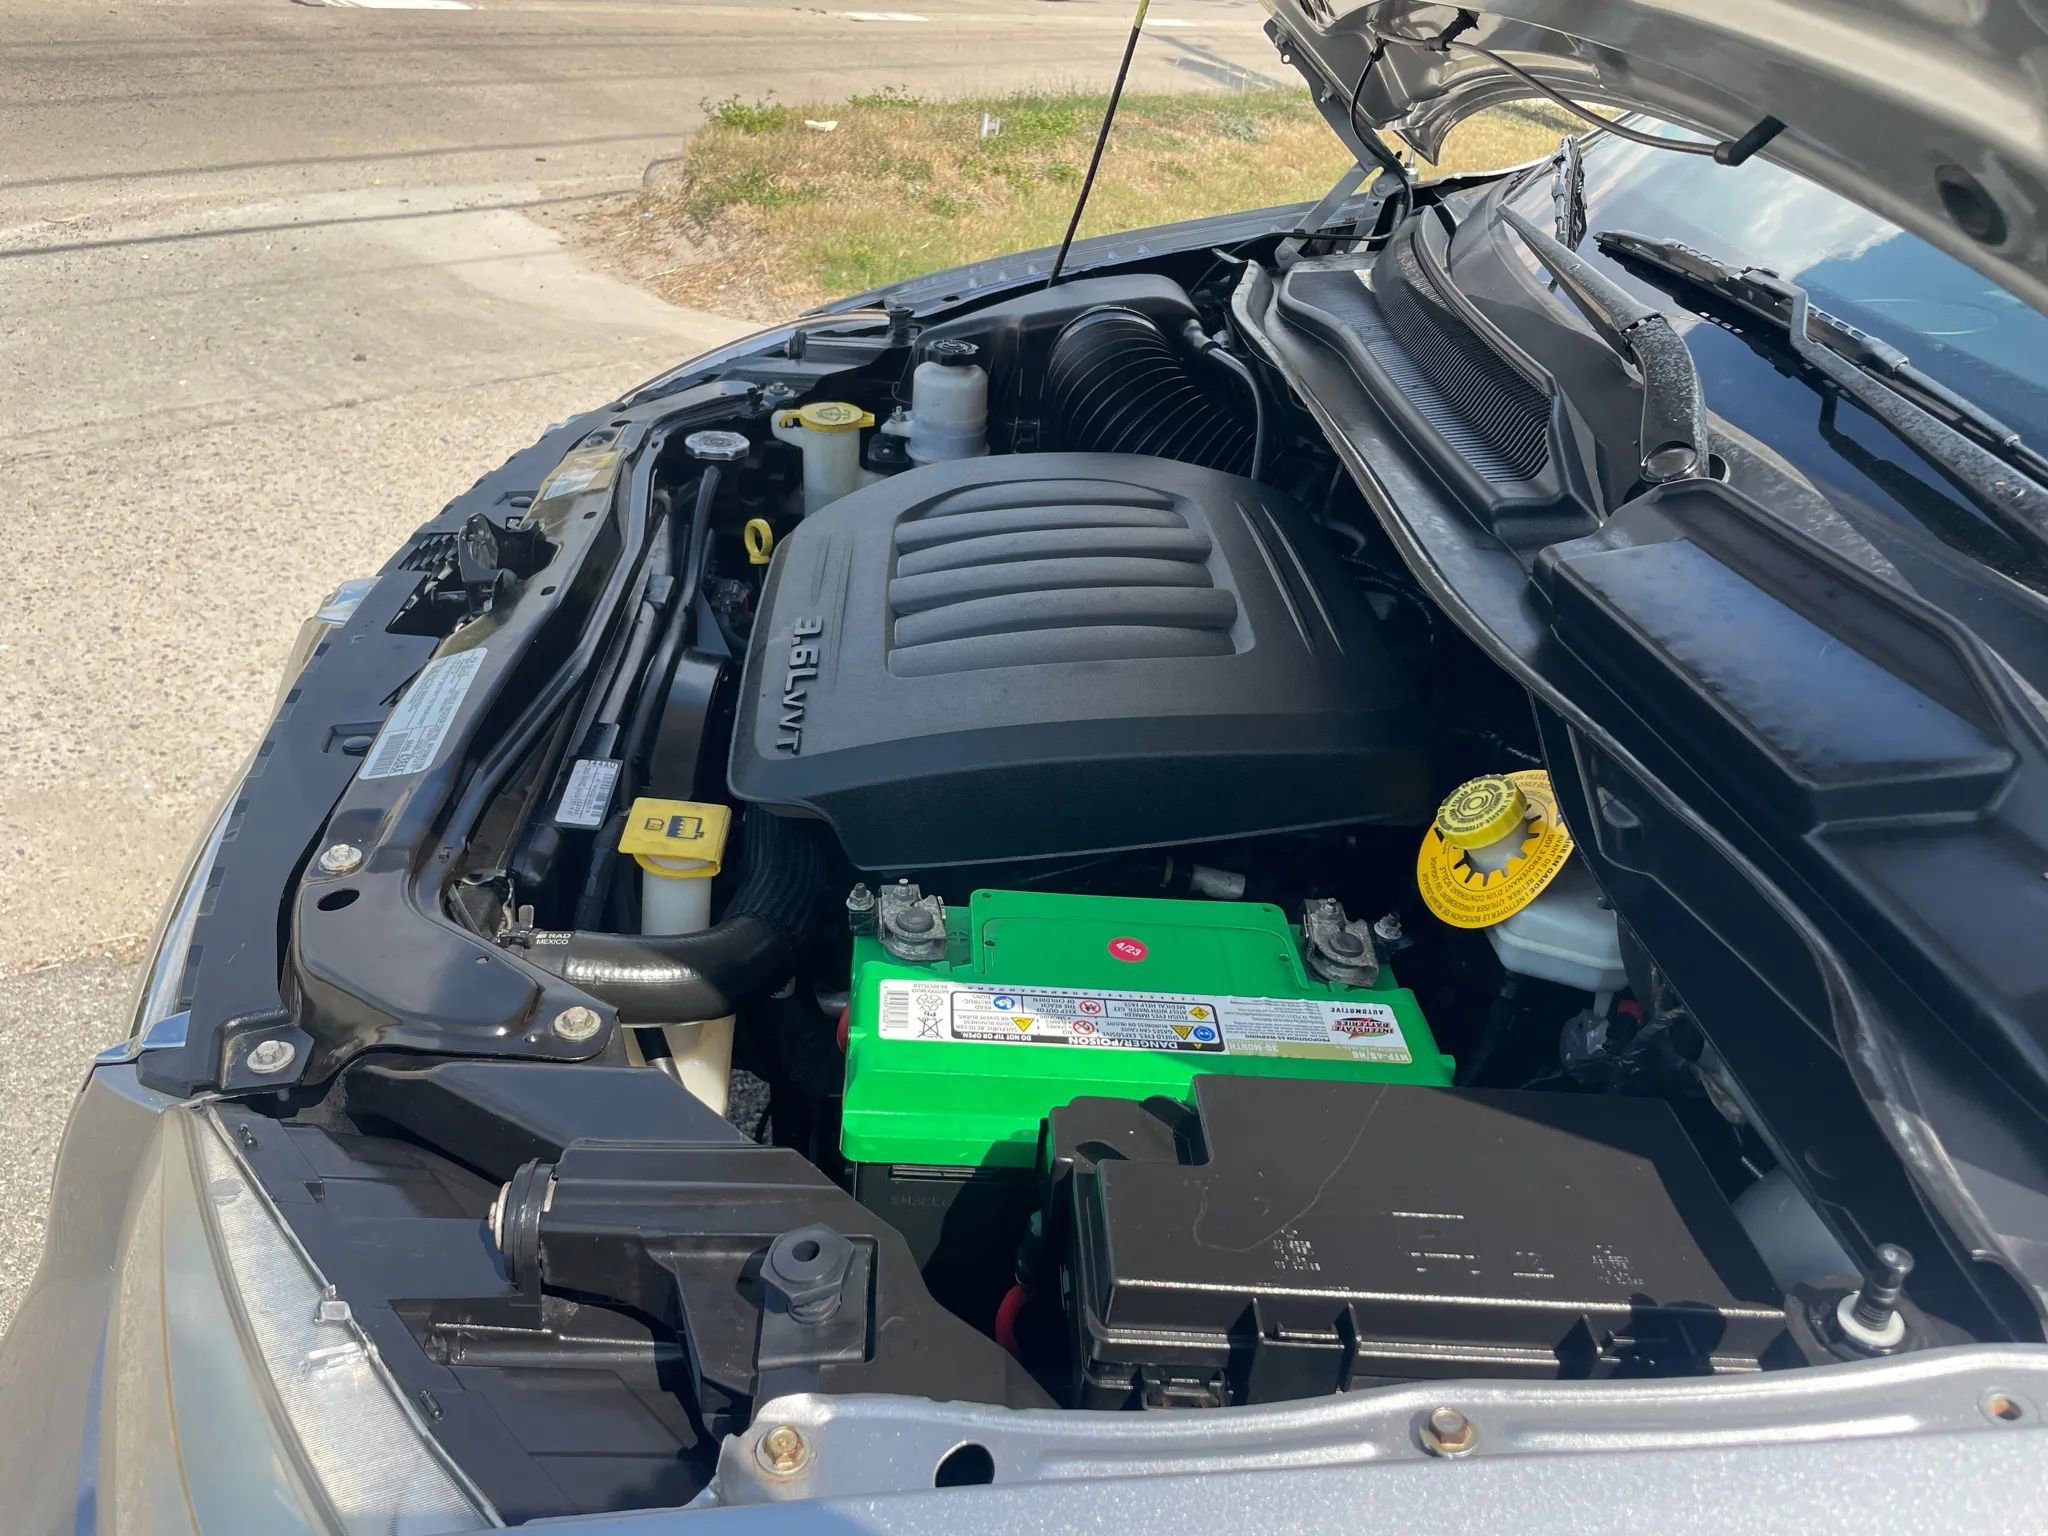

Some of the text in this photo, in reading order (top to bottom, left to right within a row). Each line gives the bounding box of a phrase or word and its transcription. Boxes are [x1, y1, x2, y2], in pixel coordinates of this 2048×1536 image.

[1543, 834, 1554, 848] DOT
[1549, 834, 1565, 857] AVANT
[1541, 858, 1551, 868] DE
[1552, 855, 1563, 867] EN
[1504, 856, 1542, 893] PROVENANT
[1533, 868, 1543, 878] LE
[1486, 889, 1503, 901] D'UN
[1116, 942, 1142, 957] 4/23
[1330, 1007, 1384, 1015] AUTOMOTIVE
[1331, 1025, 1394, 1034] INTERSTATE
[1335, 1021, 1390, 1029] BATTERIES
[1068, 1037, 1178, 1049] DANGER/POISON
